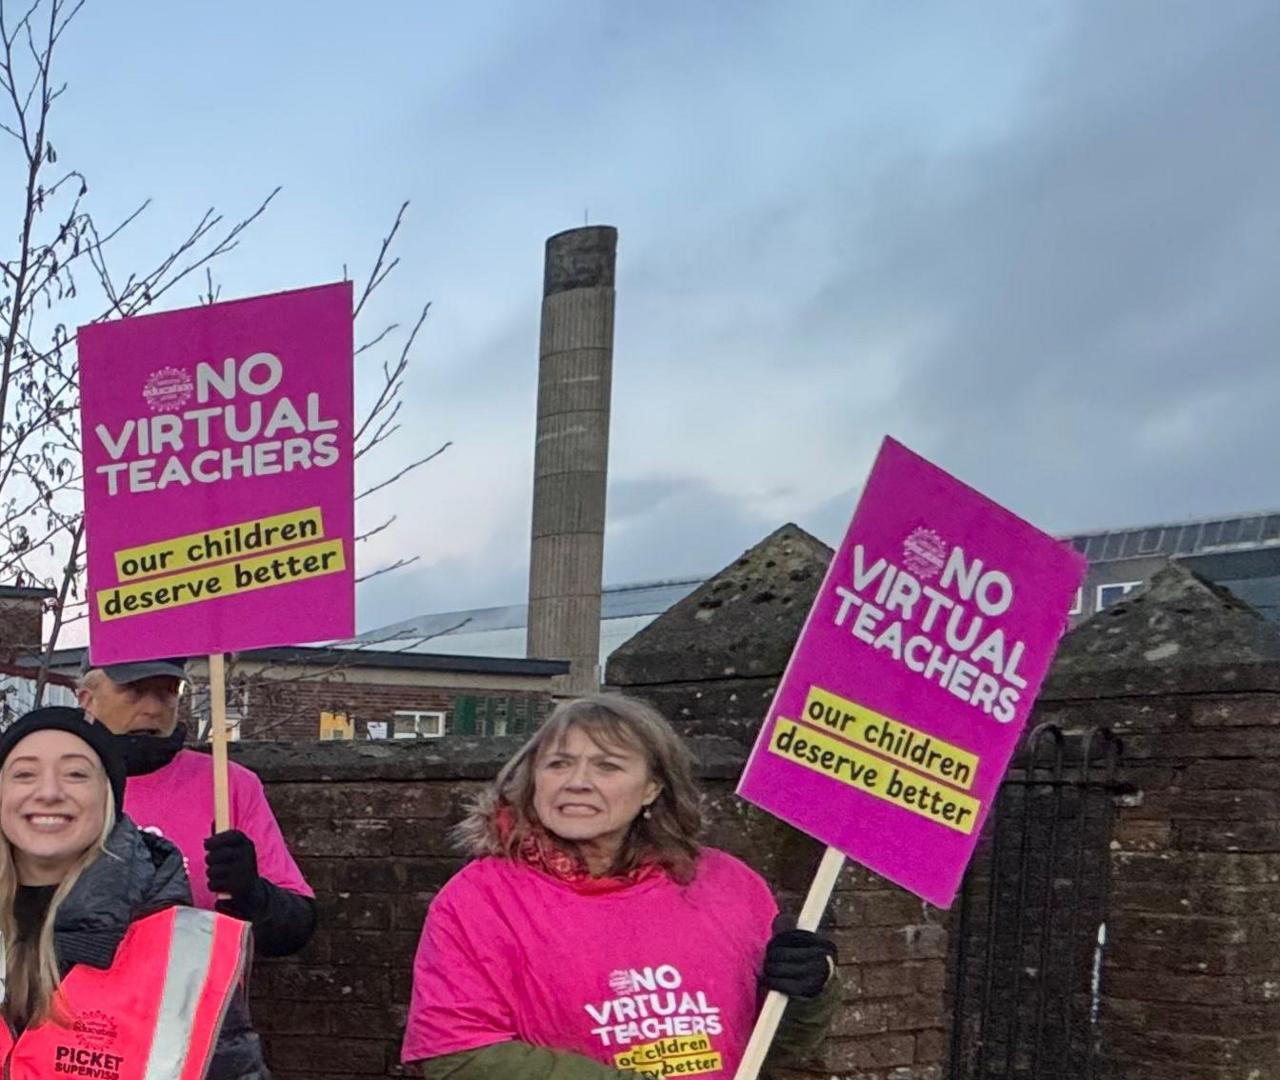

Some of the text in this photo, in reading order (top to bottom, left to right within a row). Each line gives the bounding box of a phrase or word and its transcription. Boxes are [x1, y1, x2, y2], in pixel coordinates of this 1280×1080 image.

[196, 352, 283, 403] NO
[95, 392, 339, 460] VIRTUAL
[95, 434, 339, 496] TEACHERS
[122, 517, 317, 577] our children
[104, 548, 337, 615] deserve better
[940, 547, 1013, 616] NO
[851, 544, 1027, 690] VIRTUAL
[834, 587, 1022, 724] TEACHERS
[809, 699, 971, 784] our children
[776, 726, 971, 826] deserve better
[584, 990, 720, 1026] VRTUAL
[630, 964, 682, 992] NO
[56, 1046, 124, 1071] PICKET
[645, 1039, 707, 1060] cldren
[663, 1058, 719, 1075] better
